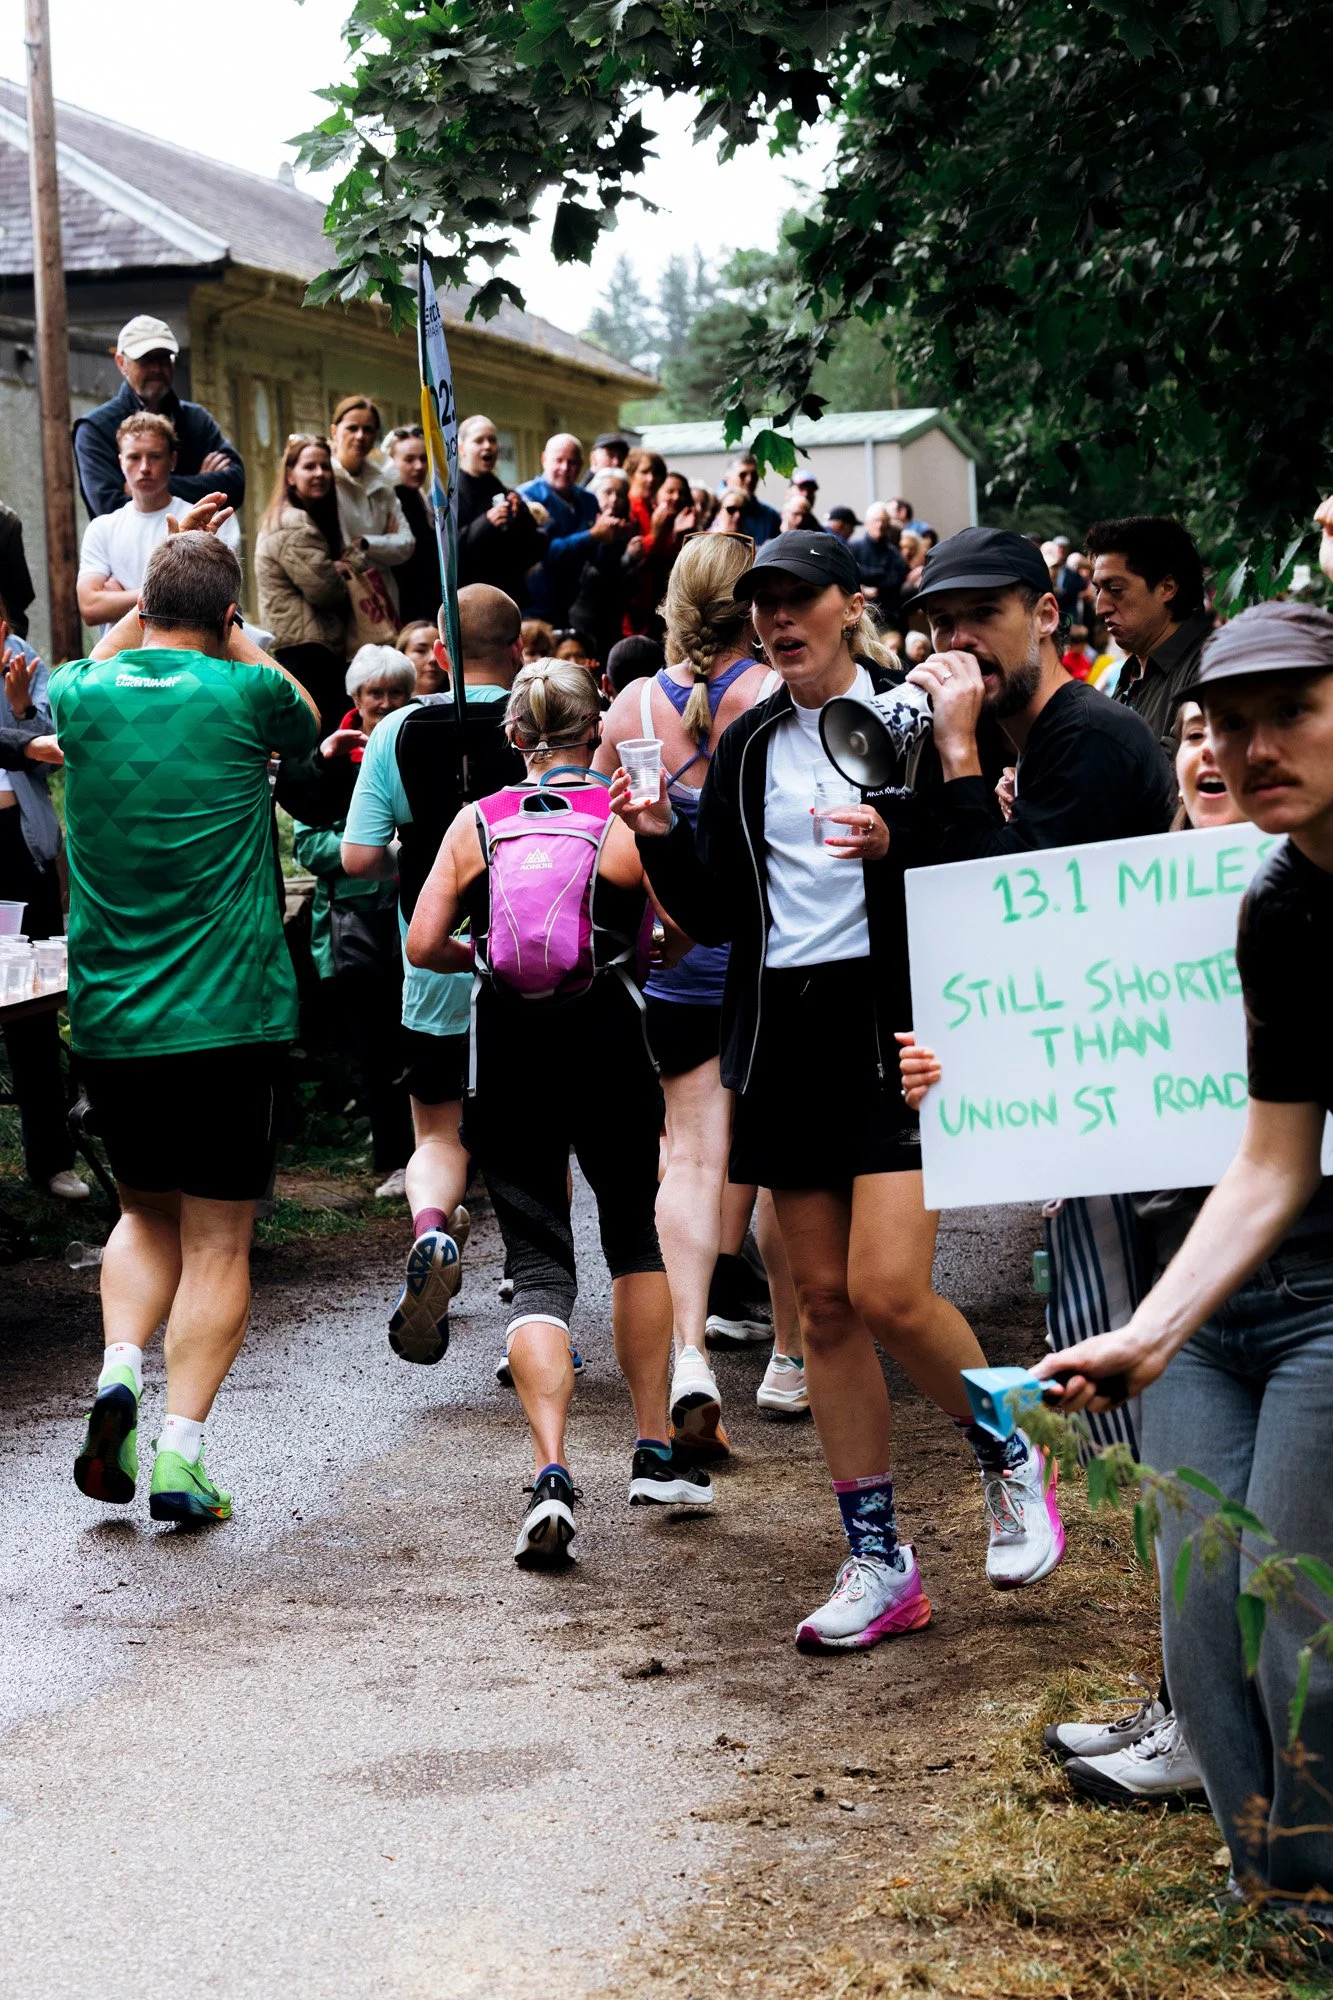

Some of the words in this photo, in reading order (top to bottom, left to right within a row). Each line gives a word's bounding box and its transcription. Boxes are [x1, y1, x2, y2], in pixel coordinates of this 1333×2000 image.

[992, 857, 1088, 924] 13.1
[941, 965, 1066, 1030] STILL
[1031, 1008, 1172, 1069] THAN
[939, 1091, 1058, 1138] UNION
[1073, 1085, 1118, 1136] ST
[1153, 1071, 1249, 1118] ROAD
